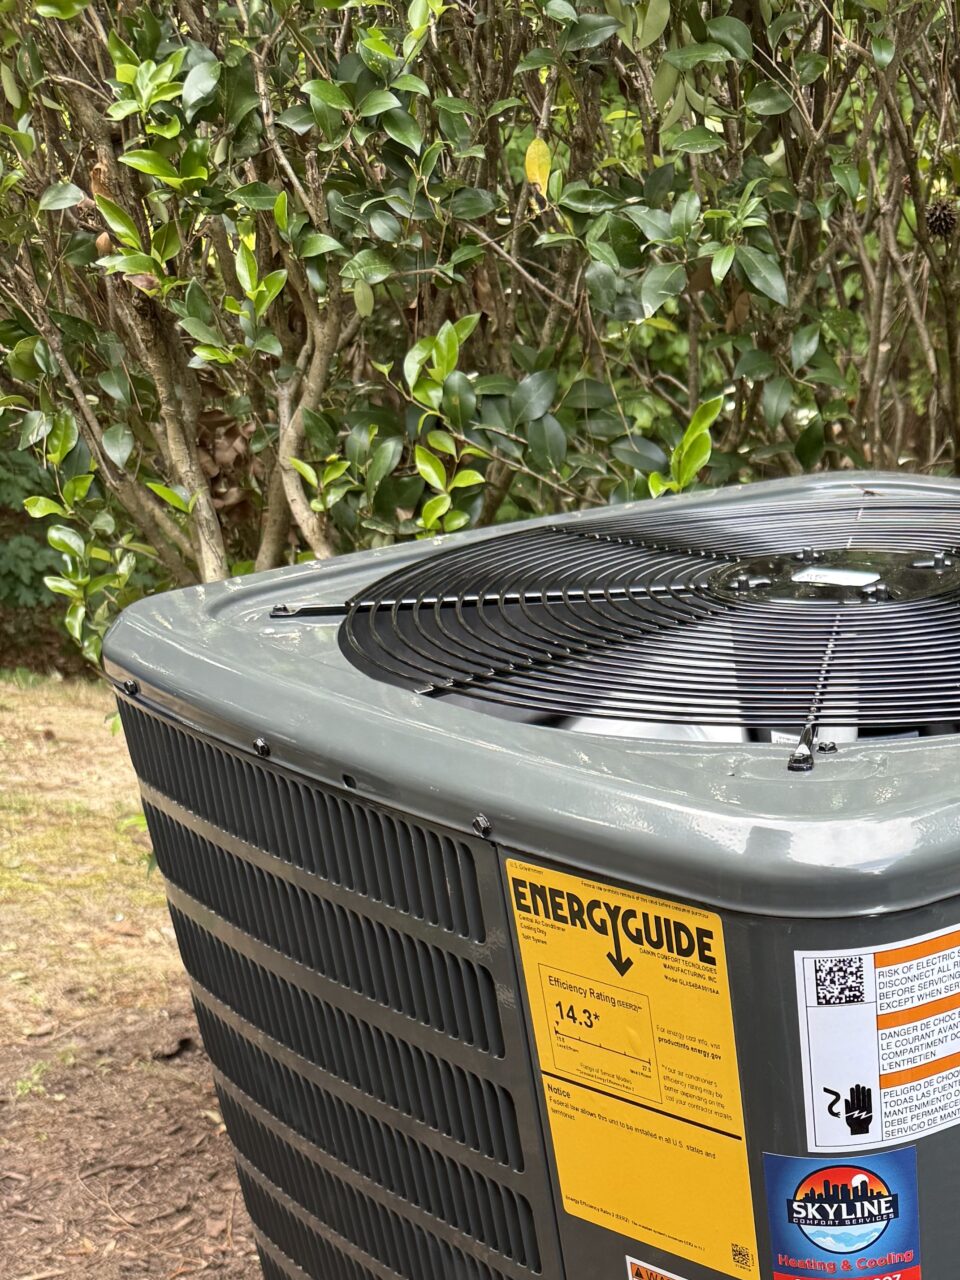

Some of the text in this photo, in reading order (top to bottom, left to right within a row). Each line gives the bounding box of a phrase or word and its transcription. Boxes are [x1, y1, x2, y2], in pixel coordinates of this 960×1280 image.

[512, 877, 716, 966] ENERGYGUIDE
[878, 967, 900, 979] RISK
[902, 964, 914, 974] OF
[916, 950, 956, 970] ELECTRIC
[878, 969, 934, 990] DISCONNECT
[936, 964, 951, 974] ALL
[548, 976, 616, 1007] Efficiency Rating
[879, 986, 916, 1000] BEFORE
[880, 995, 915, 1011] EXCEPT
[918, 988, 942, 1002] WHEN
[547, 1084, 571, 1098] Notice
[884, 1084, 921, 1098] PELIGRO
[924, 1079, 934, 1089] DE
[885, 1117, 908, 1128] DEBE
[885, 1122, 926, 1137] SERVICIO
[928, 1117, 938, 1126] DE
[792, 1197, 894, 1220] SKYLINE
[792, 1213, 894, 1226] COMFORT SERVICES
[778, 1254, 836, 1272] Heating
[840, 1260, 851, 1271] &
[856, 1250, 914, 1270] Cooling
